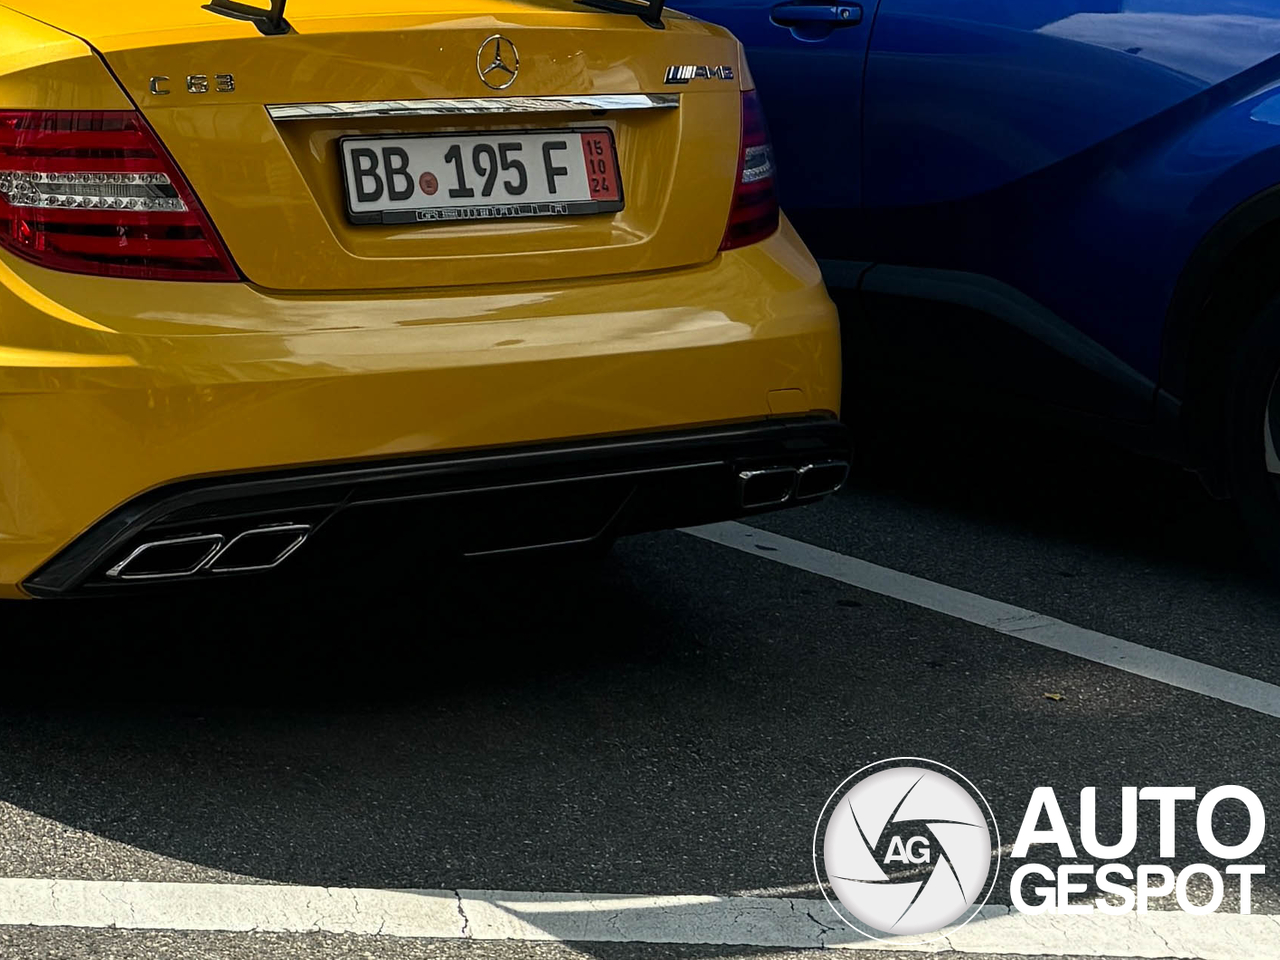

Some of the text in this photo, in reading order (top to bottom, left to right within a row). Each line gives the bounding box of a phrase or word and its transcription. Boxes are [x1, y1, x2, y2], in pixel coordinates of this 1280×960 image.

[149, 73, 236, 95] C 63
[586, 139, 604, 156] 15
[350, 140, 568, 202] BB 195 F
[589, 158, 606, 175] 10
